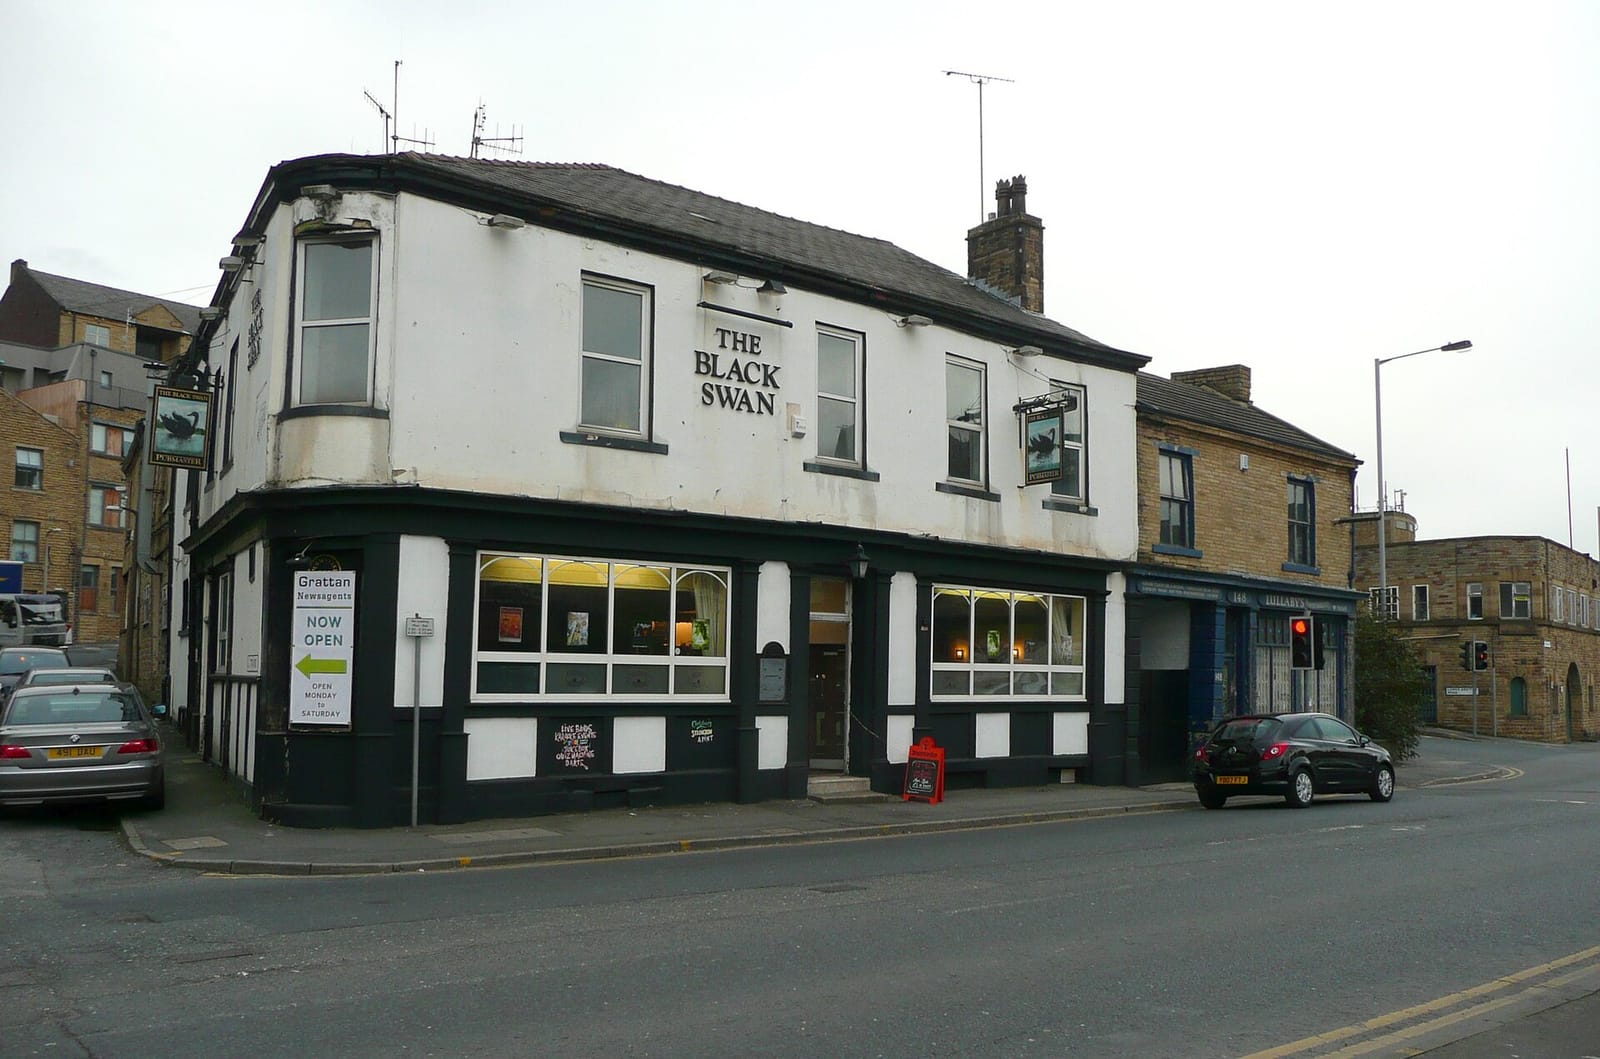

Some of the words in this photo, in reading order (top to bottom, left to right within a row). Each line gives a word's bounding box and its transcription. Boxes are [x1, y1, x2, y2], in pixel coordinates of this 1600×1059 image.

[716, 327, 762, 355] THE
[694, 350, 781, 389] BLACK
[701, 382, 776, 416] SWAN
[298, 576, 351, 587] Grattan
[297, 592, 352, 601] Newsagents
[1233, 592, 1247, 603] 148
[307, 616, 341, 628] NOW
[304, 634, 343, 646] OPEN
